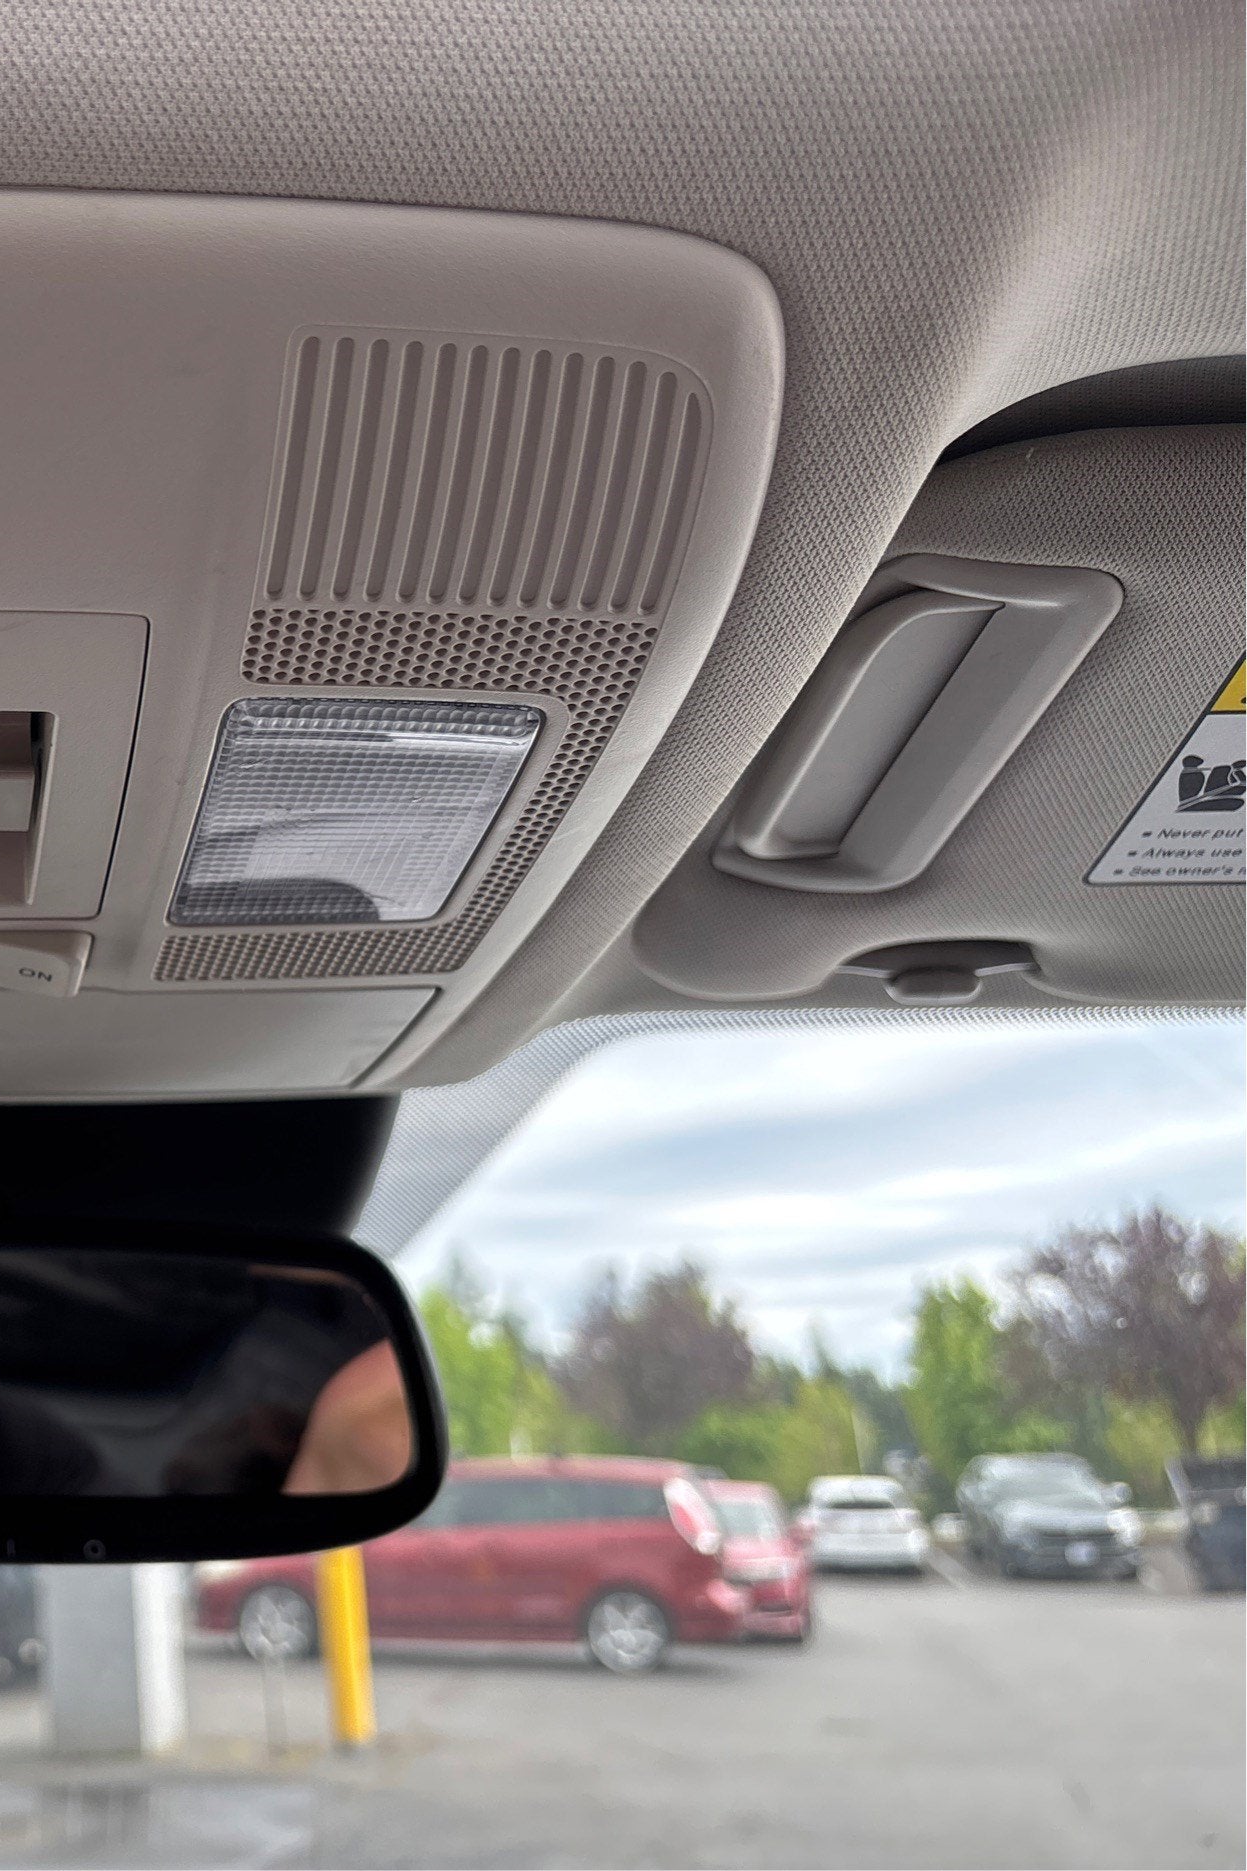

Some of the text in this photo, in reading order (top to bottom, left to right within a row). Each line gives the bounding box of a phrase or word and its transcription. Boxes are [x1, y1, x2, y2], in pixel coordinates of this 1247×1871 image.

[1157, 827, 1244, 841] Never put
[1142, 848, 1243, 860] Always use
[1129, 865, 1161, 877] See
[1165, 865, 1233, 876] owner's
[18, 966, 53, 982] ON
